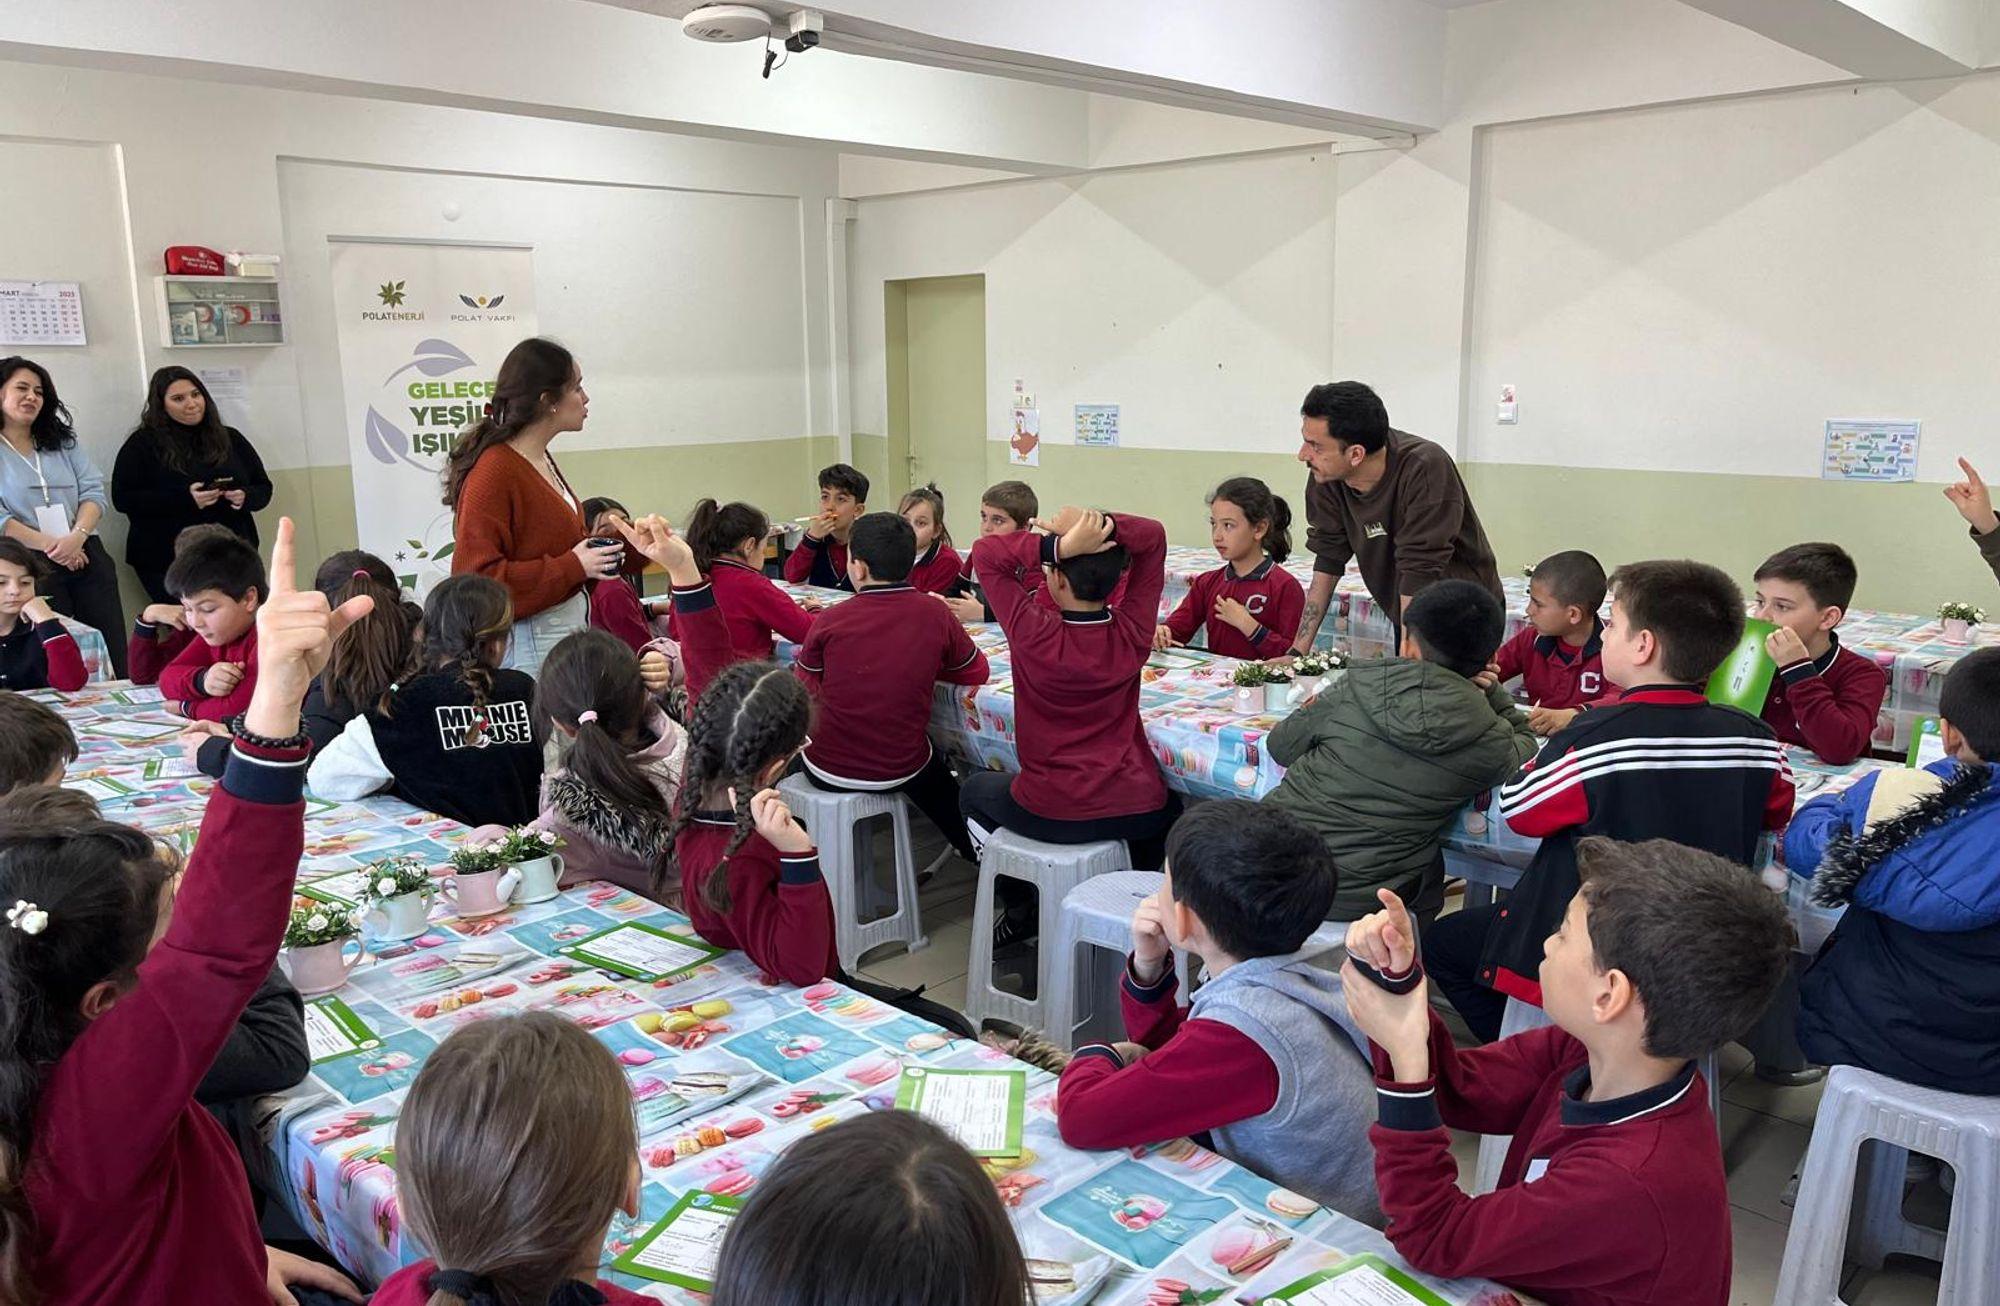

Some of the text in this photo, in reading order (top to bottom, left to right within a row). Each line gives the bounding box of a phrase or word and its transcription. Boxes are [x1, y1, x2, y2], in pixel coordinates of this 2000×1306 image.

[362, 311, 425, 321] POLATENERJİ
[451, 314, 516, 322] POLAT VAKFI
[408, 381, 497, 399] GELECE
[412, 432, 461, 457] IŞIK
[1245, 594, 1268, 615] C
[1580, 671, 1601, 693] C
[437, 702, 527, 728] MINIE
[442, 722, 532, 750] MUSE
